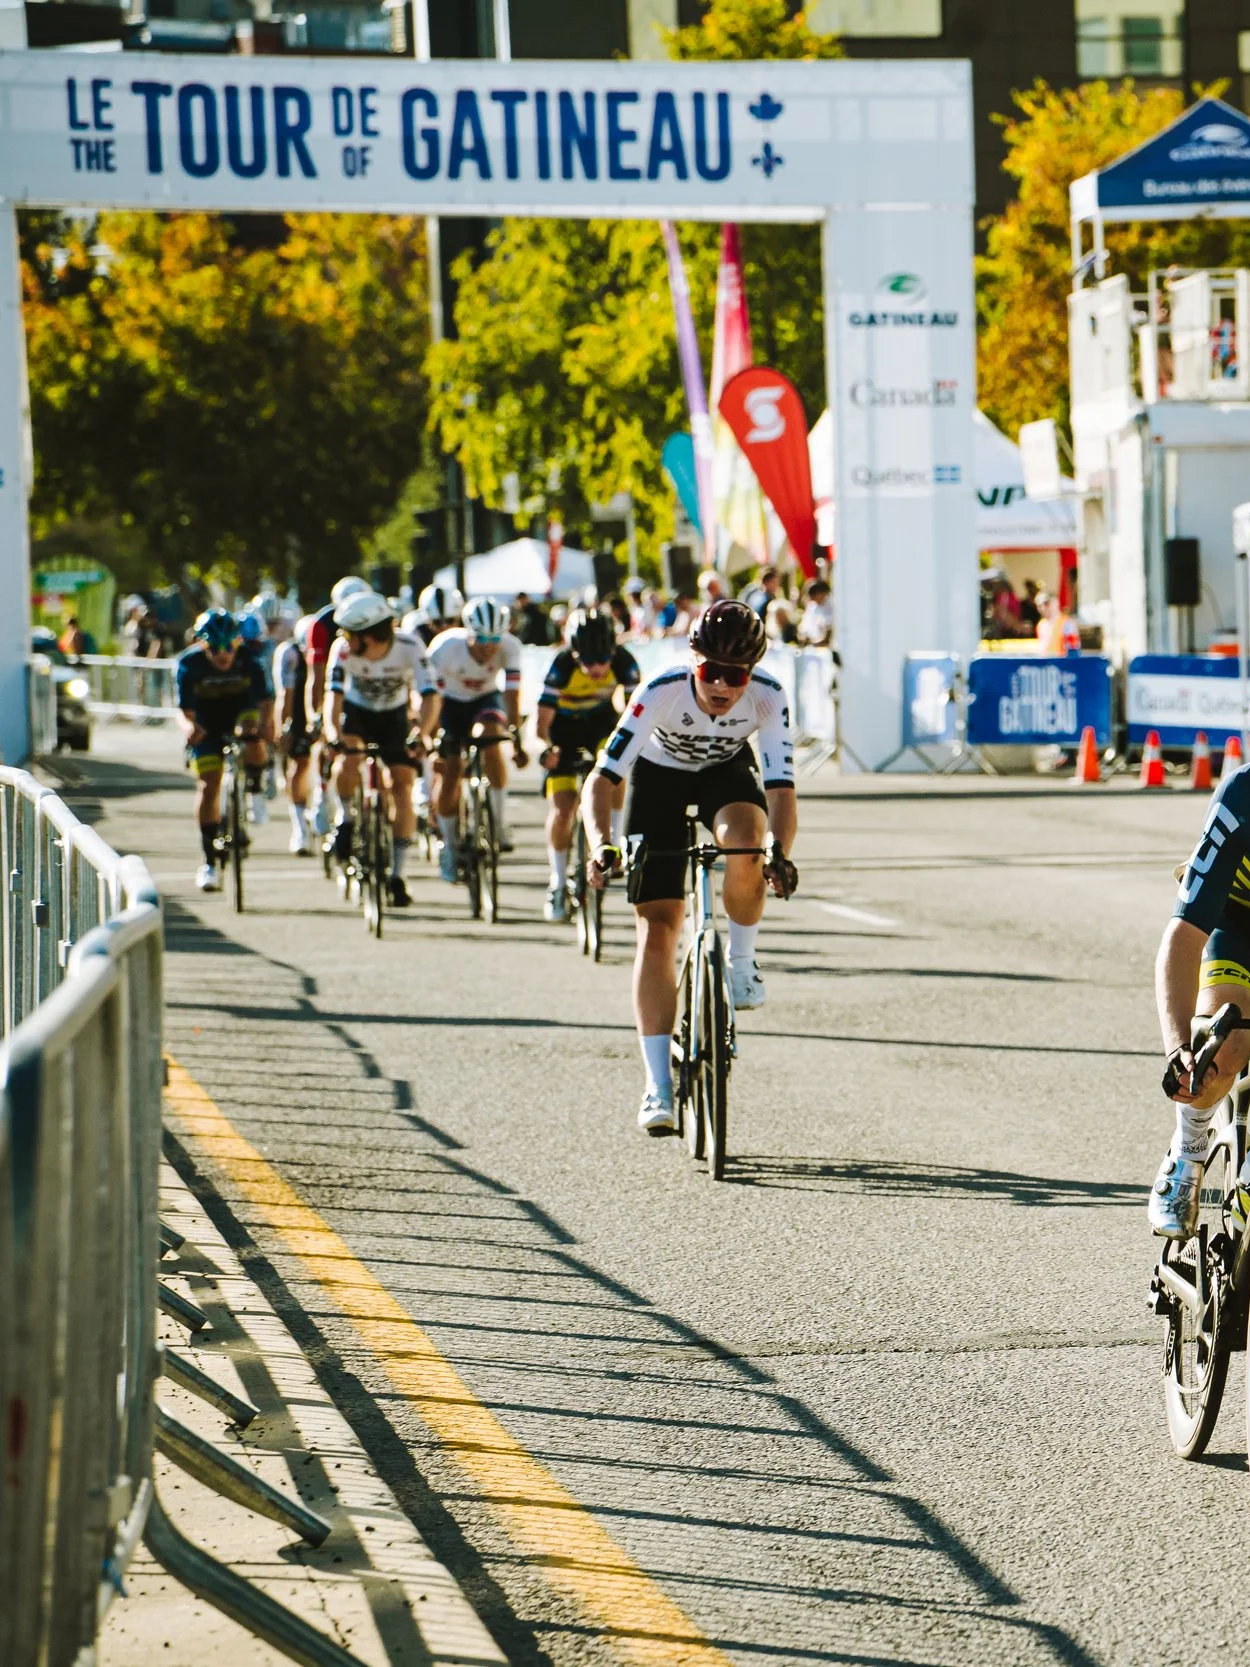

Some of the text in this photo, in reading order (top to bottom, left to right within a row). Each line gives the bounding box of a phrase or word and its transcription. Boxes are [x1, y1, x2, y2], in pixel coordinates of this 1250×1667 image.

[66, 78, 732, 181] LE TOUR DE GATINEAU
[69, 138, 371, 177] THE OF
[850, 310, 958, 328] GATINEAU
[850, 378, 957, 408] Canada
